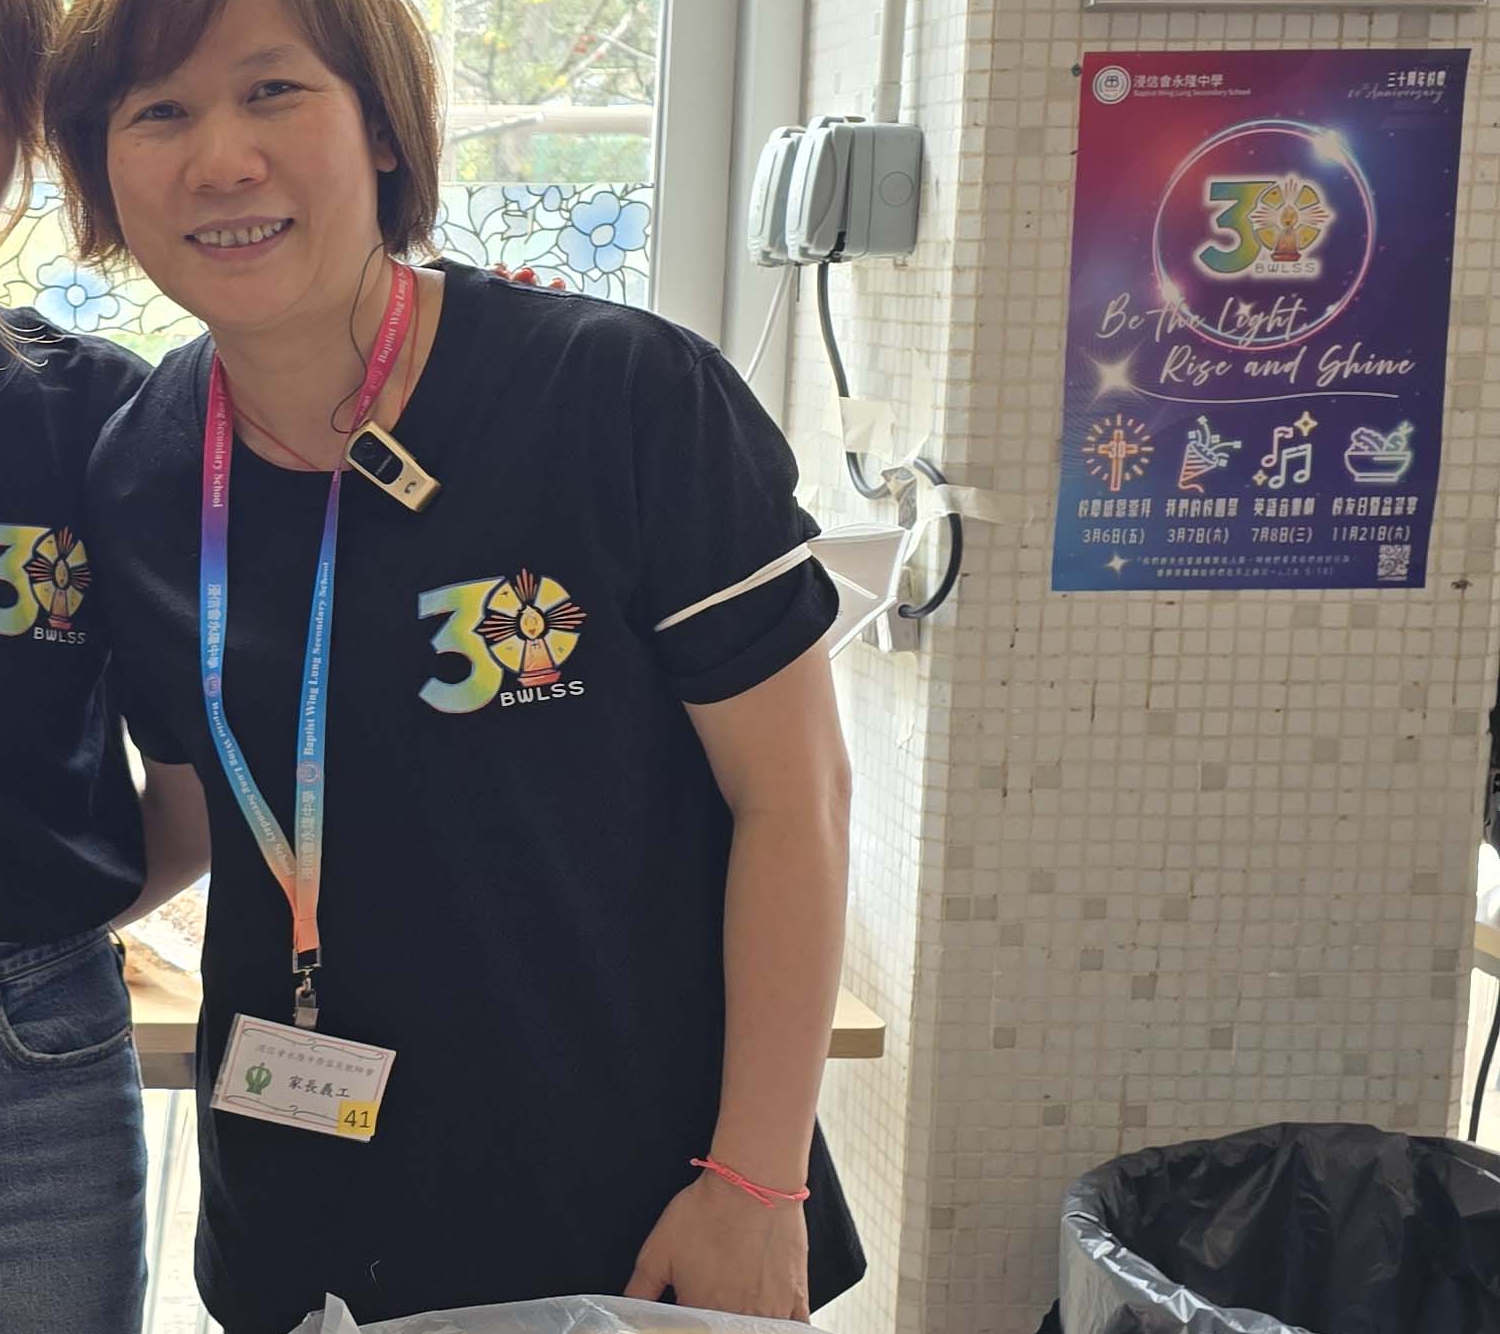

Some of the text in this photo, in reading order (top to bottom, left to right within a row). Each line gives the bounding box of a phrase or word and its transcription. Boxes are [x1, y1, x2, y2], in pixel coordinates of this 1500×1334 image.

[1255, 262, 1317, 274] BWLSS
[1096, 292, 1145, 338] Be
[378, 327, 397, 363] Baptist
[1159, 346, 1233, 386] Rise
[1243, 346, 1307, 384] and
[213, 420, 228, 471] Secondary
[212, 473, 224, 508] School
[33, 627, 87, 644] BWLSS
[303, 562, 328, 756] Baptist Wing Lung Secondary School
[500, 680, 585, 707] BWLSS
[224, 736, 238, 766] Wing
[234, 767, 251, 794] Lung
[248, 793, 276, 844] Secondary
[289, 1075, 351, 1098] 家長義工
[344, 1109, 371, 1128] 41
